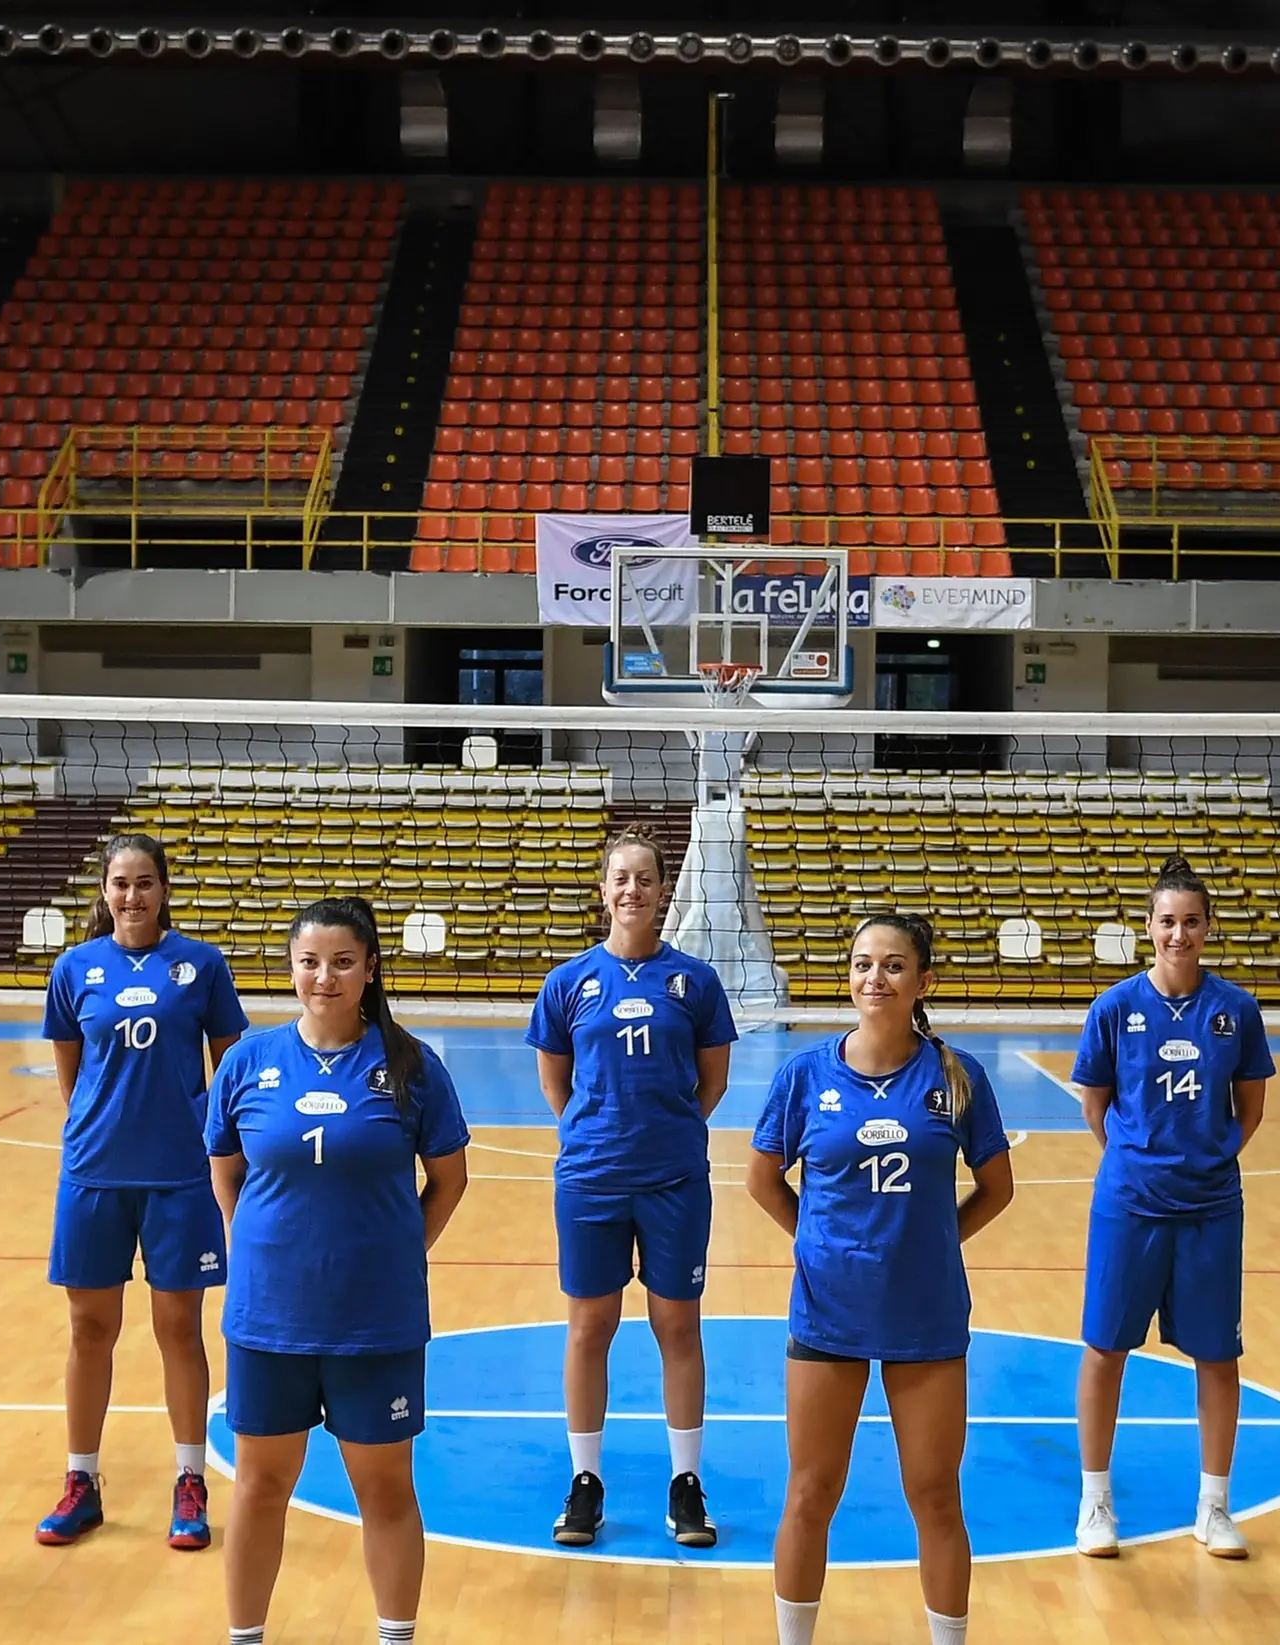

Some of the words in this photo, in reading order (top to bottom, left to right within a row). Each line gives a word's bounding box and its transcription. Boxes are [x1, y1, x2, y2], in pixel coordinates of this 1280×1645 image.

[922, 588, 1026, 606] EVERMIND
[114, 1016, 158, 1050] 10
[616, 1025, 651, 1056] 11
[1156, 1069, 1202, 1102] 14
[301, 1126, 325, 1165] 1
[861, 1130, 904, 1140] SORBELLO
[858, 1152, 912, 1194] 12
